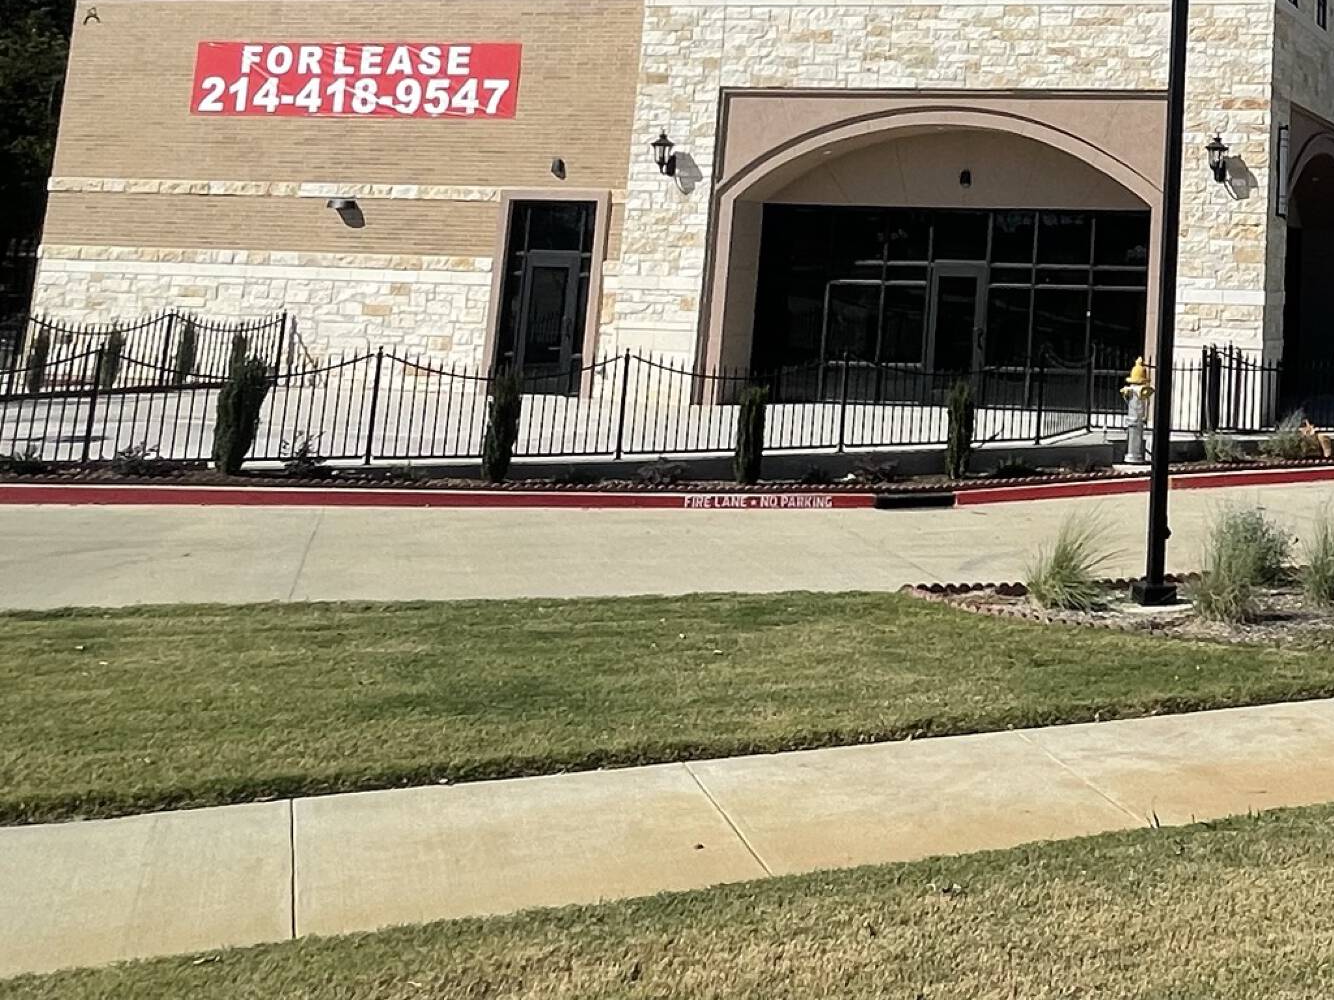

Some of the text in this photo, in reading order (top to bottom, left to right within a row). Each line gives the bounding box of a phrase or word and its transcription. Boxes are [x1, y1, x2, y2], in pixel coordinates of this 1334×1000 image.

[241, 45, 472, 76] FOR LEASE
[198, 76, 510, 114] 214-418-9547
[684, 495, 833, 508] FIRE LANE NO PARKING
